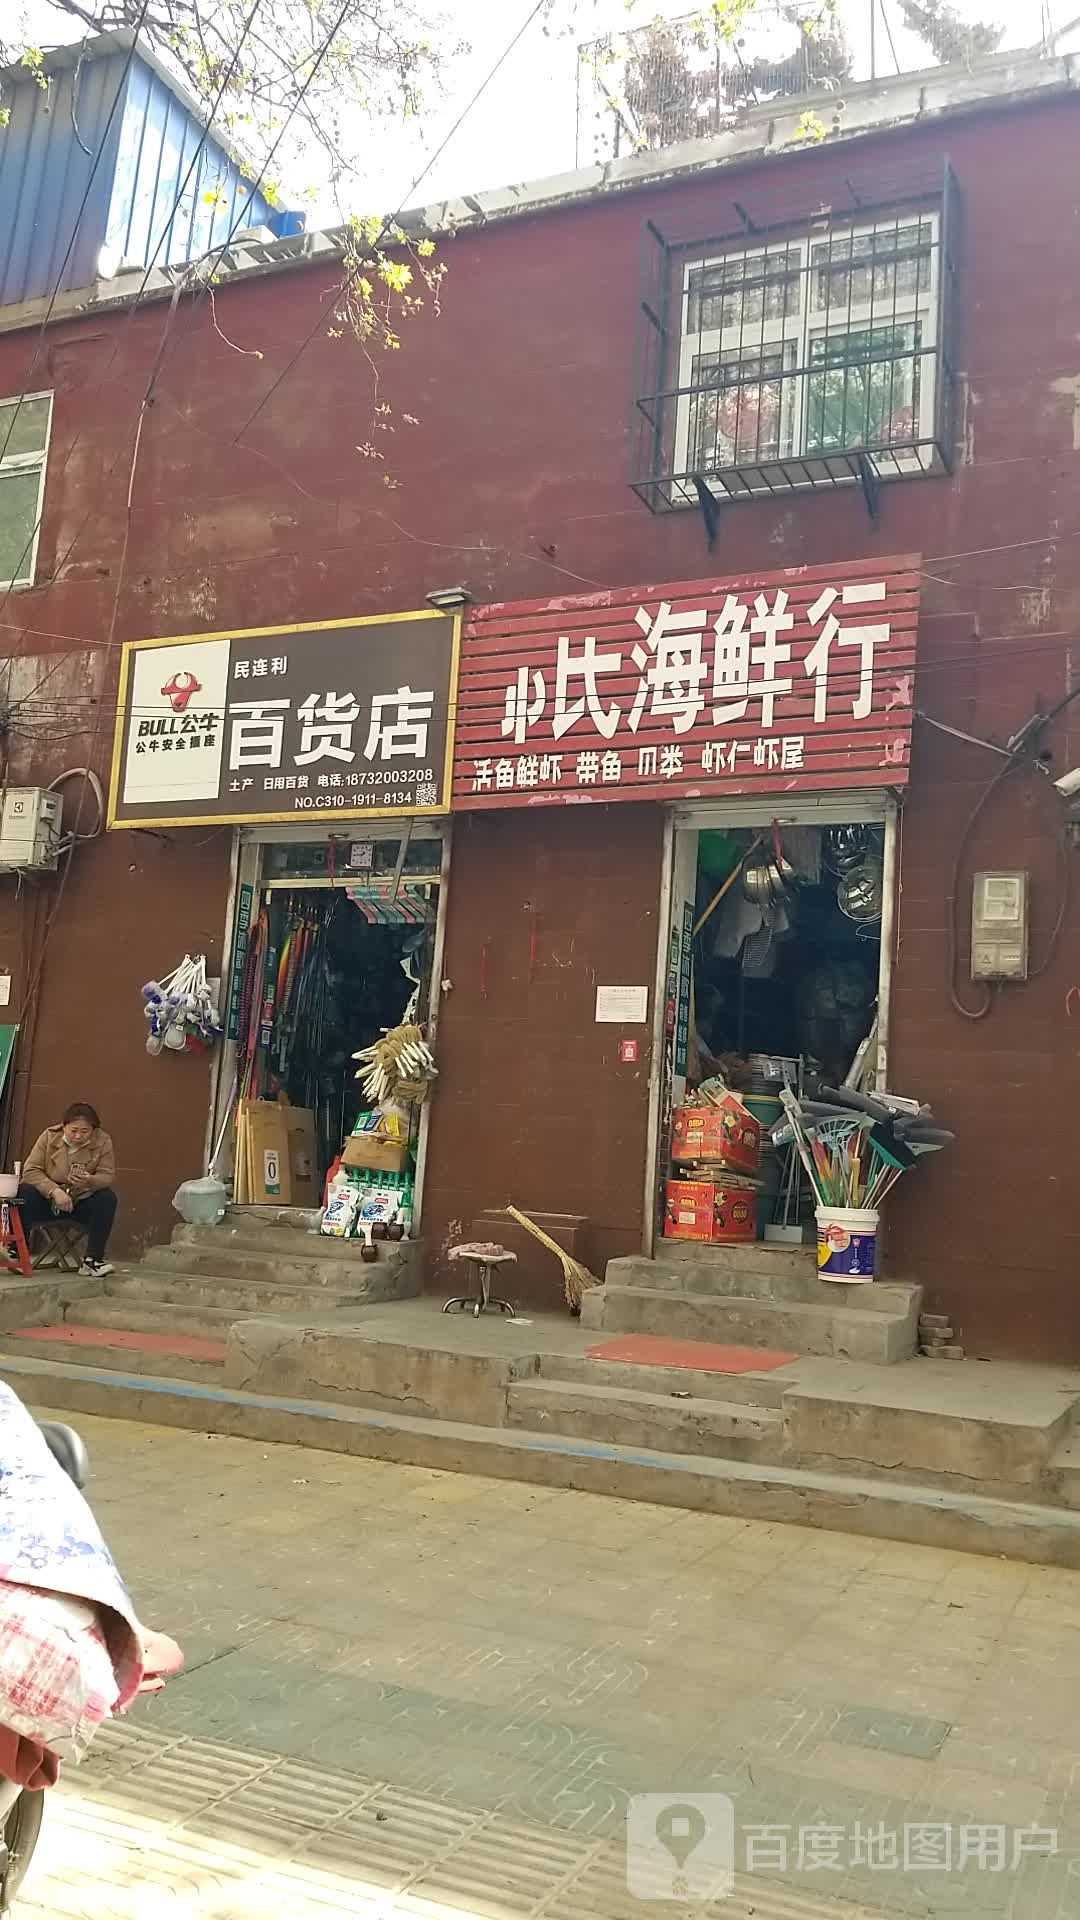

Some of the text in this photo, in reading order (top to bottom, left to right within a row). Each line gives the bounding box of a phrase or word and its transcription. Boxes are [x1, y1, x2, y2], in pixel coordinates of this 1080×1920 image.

[233, 655, 287, 679] 民连利
[228, 686, 435, 771] 百货店
[135, 734, 216, 753] 公牛安全插座
[471, 753, 563, 791] 活鱼鲜虾
[576, 750, 622, 784] 带鱼
[228, 777, 254, 792] 土产
[263, 774, 309, 791] 日用百货
